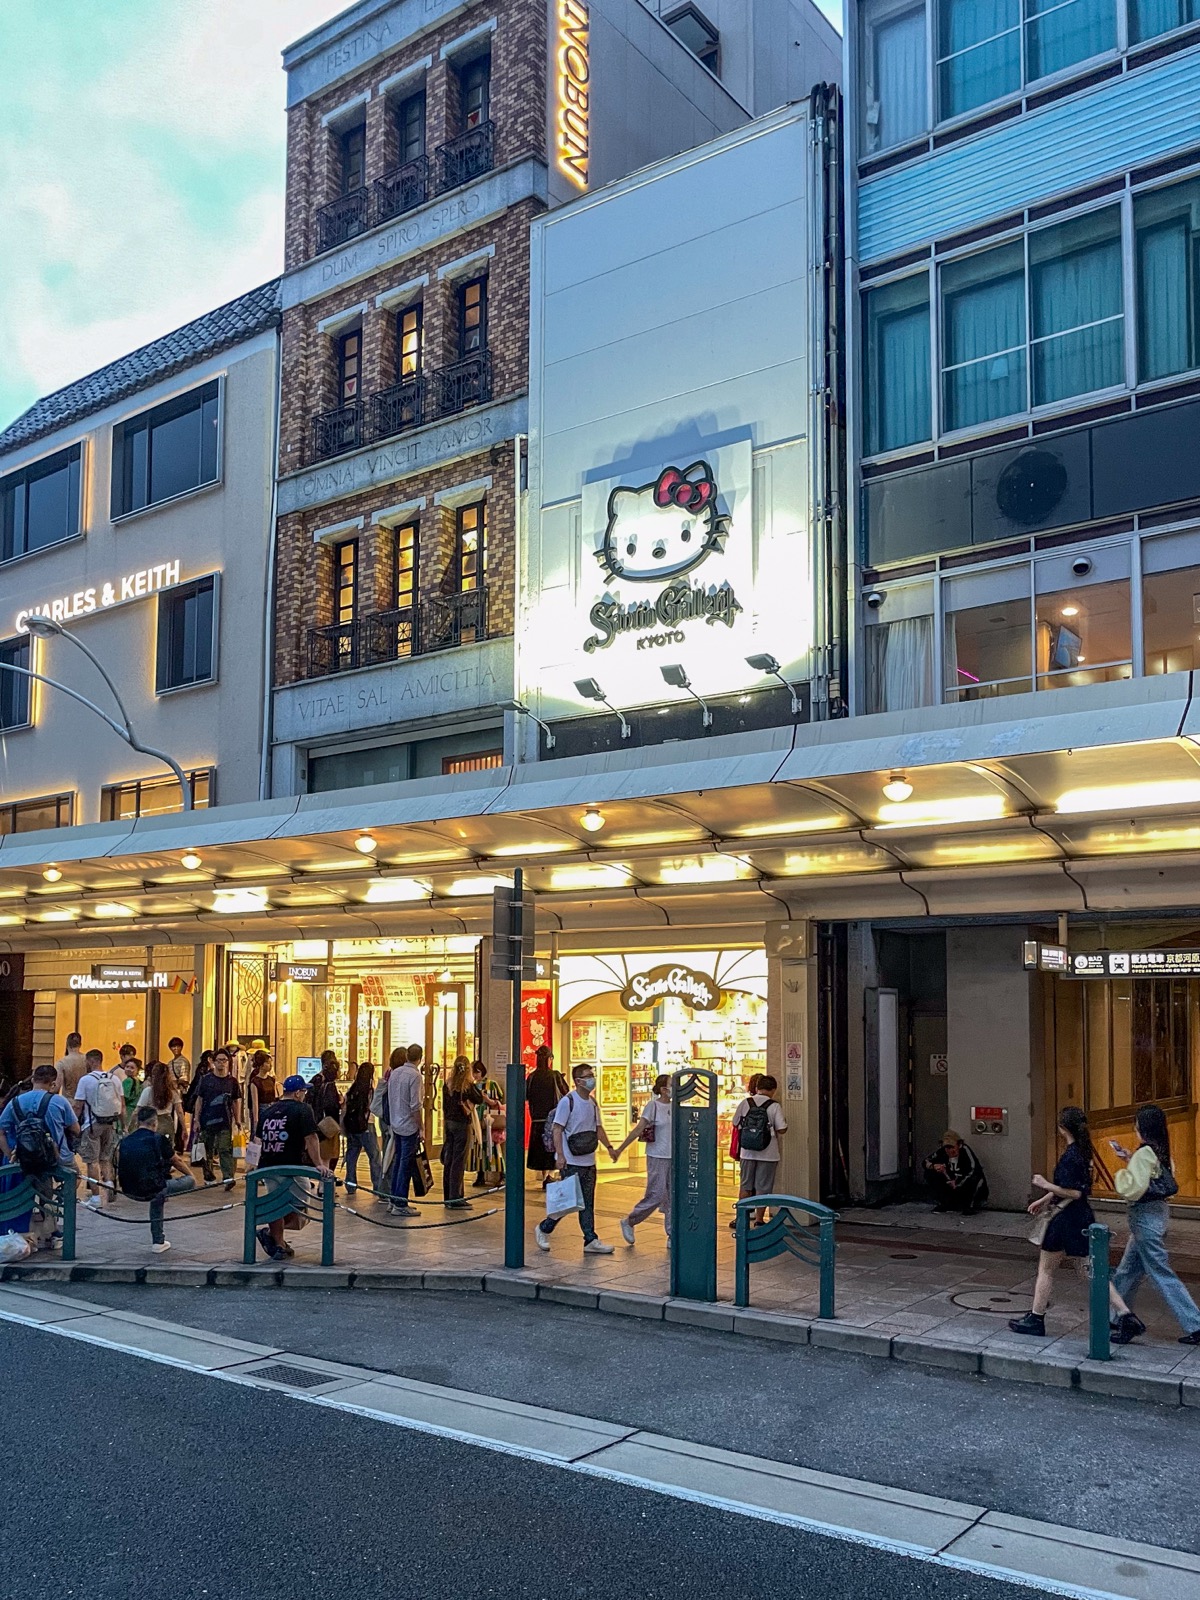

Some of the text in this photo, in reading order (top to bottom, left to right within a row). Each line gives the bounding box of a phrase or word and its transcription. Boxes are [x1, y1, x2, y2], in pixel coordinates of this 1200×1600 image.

[326, 21, 392, 74] FESTINA
[322, 251, 358, 282] DUM
[432, 194, 480, 230] SPERO
[302, 417, 493, 497] OMNIA VINCIT AMOR
[101, 582, 115, 607] &
[121, 559, 180, 601] KEITH
[656, 584, 743, 629] Gallery
[636, 630, 686, 651] KYOTO
[298, 666, 496, 720] VITAE SAL AMICITIA
[288, 967, 318, 977] INOBUN
